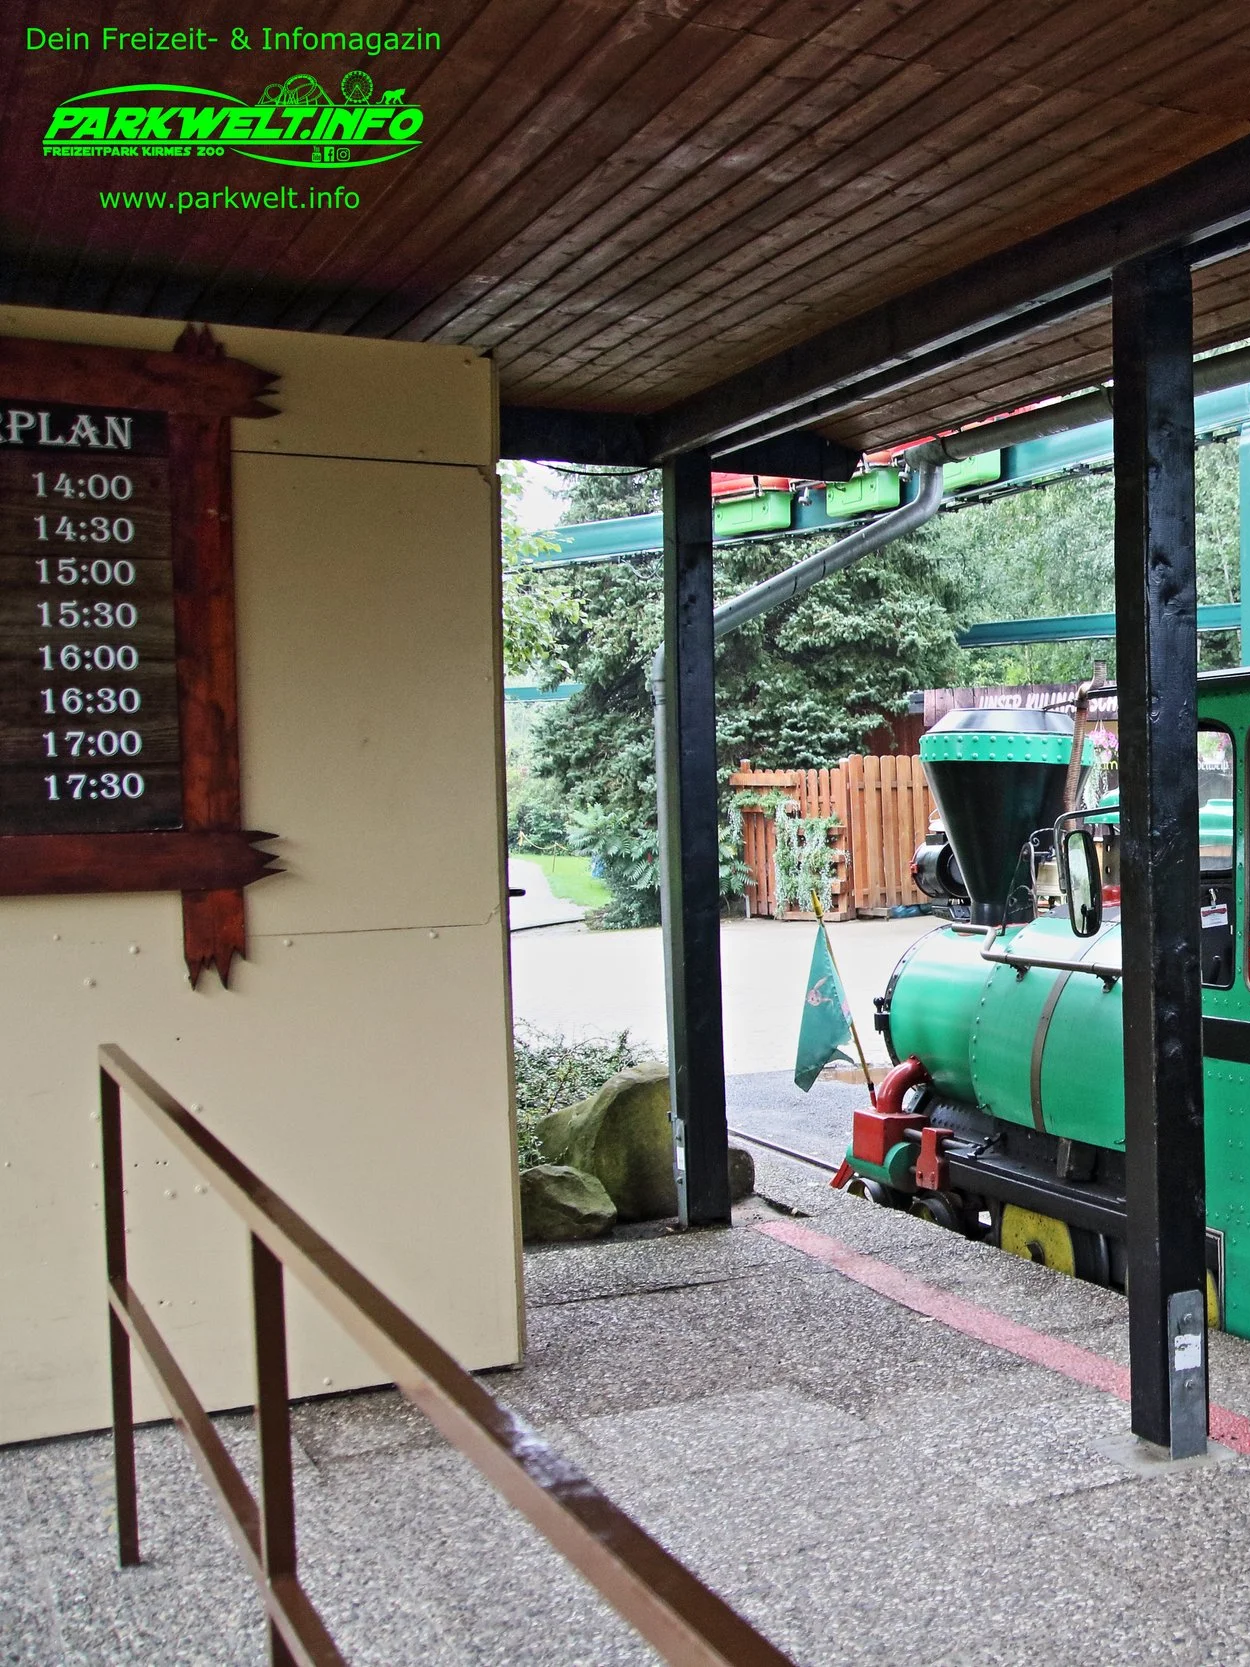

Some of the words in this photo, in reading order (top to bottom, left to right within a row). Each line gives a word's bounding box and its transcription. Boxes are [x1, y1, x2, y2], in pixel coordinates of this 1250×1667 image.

[32, 472, 133, 500] 14:00
[34, 515, 135, 543] 14:30
[35, 557, 136, 585] 15:00
[37, 600, 138, 628] 15:30
[39, 644, 140, 671] 16:00
[40, 687, 142, 714] 16:30
[42, 730, 143, 758] 17:00
[44, 772, 145, 800] 17:30
